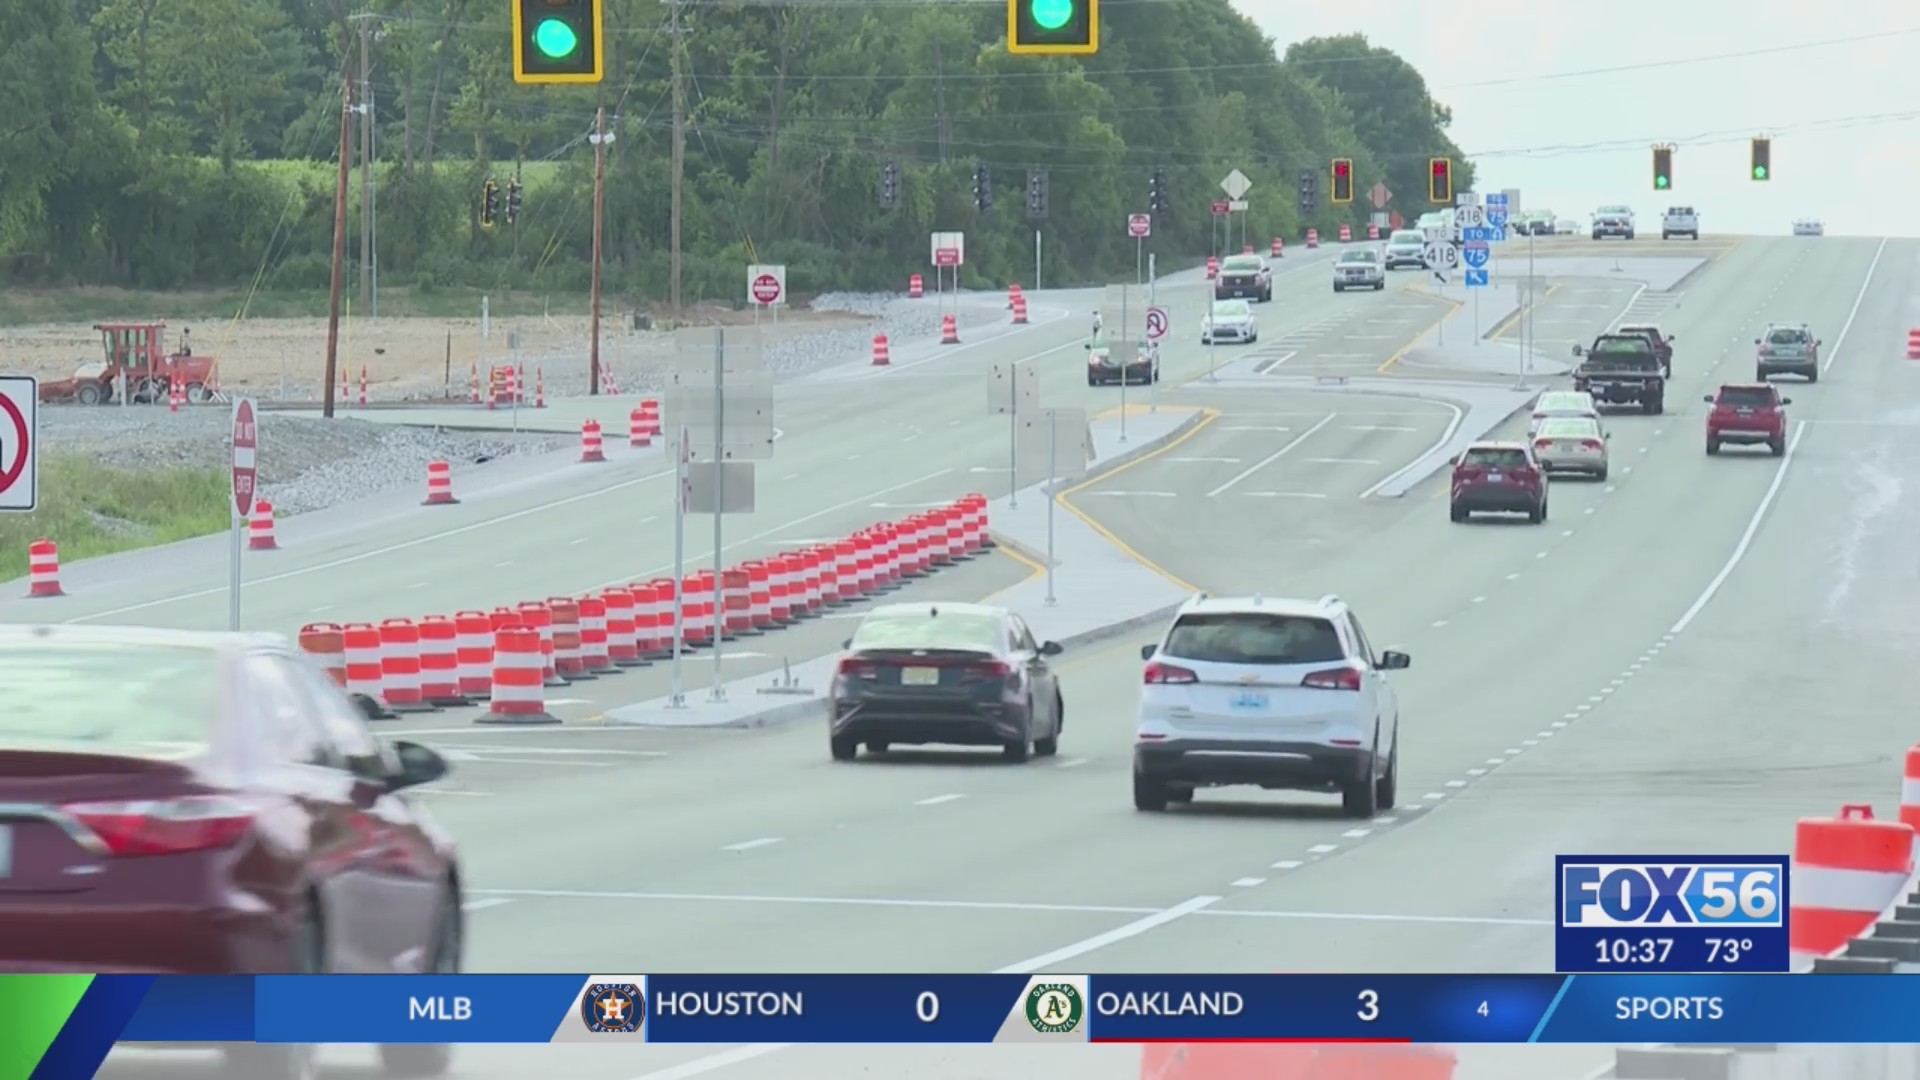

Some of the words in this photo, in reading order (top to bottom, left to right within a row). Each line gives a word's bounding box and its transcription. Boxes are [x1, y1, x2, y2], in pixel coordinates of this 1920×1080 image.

[1456, 210, 1480, 222] 418
[1470, 230, 1484, 238] TO
[1427, 247, 1456, 263] 418
[1468, 249, 1486, 260] 75
